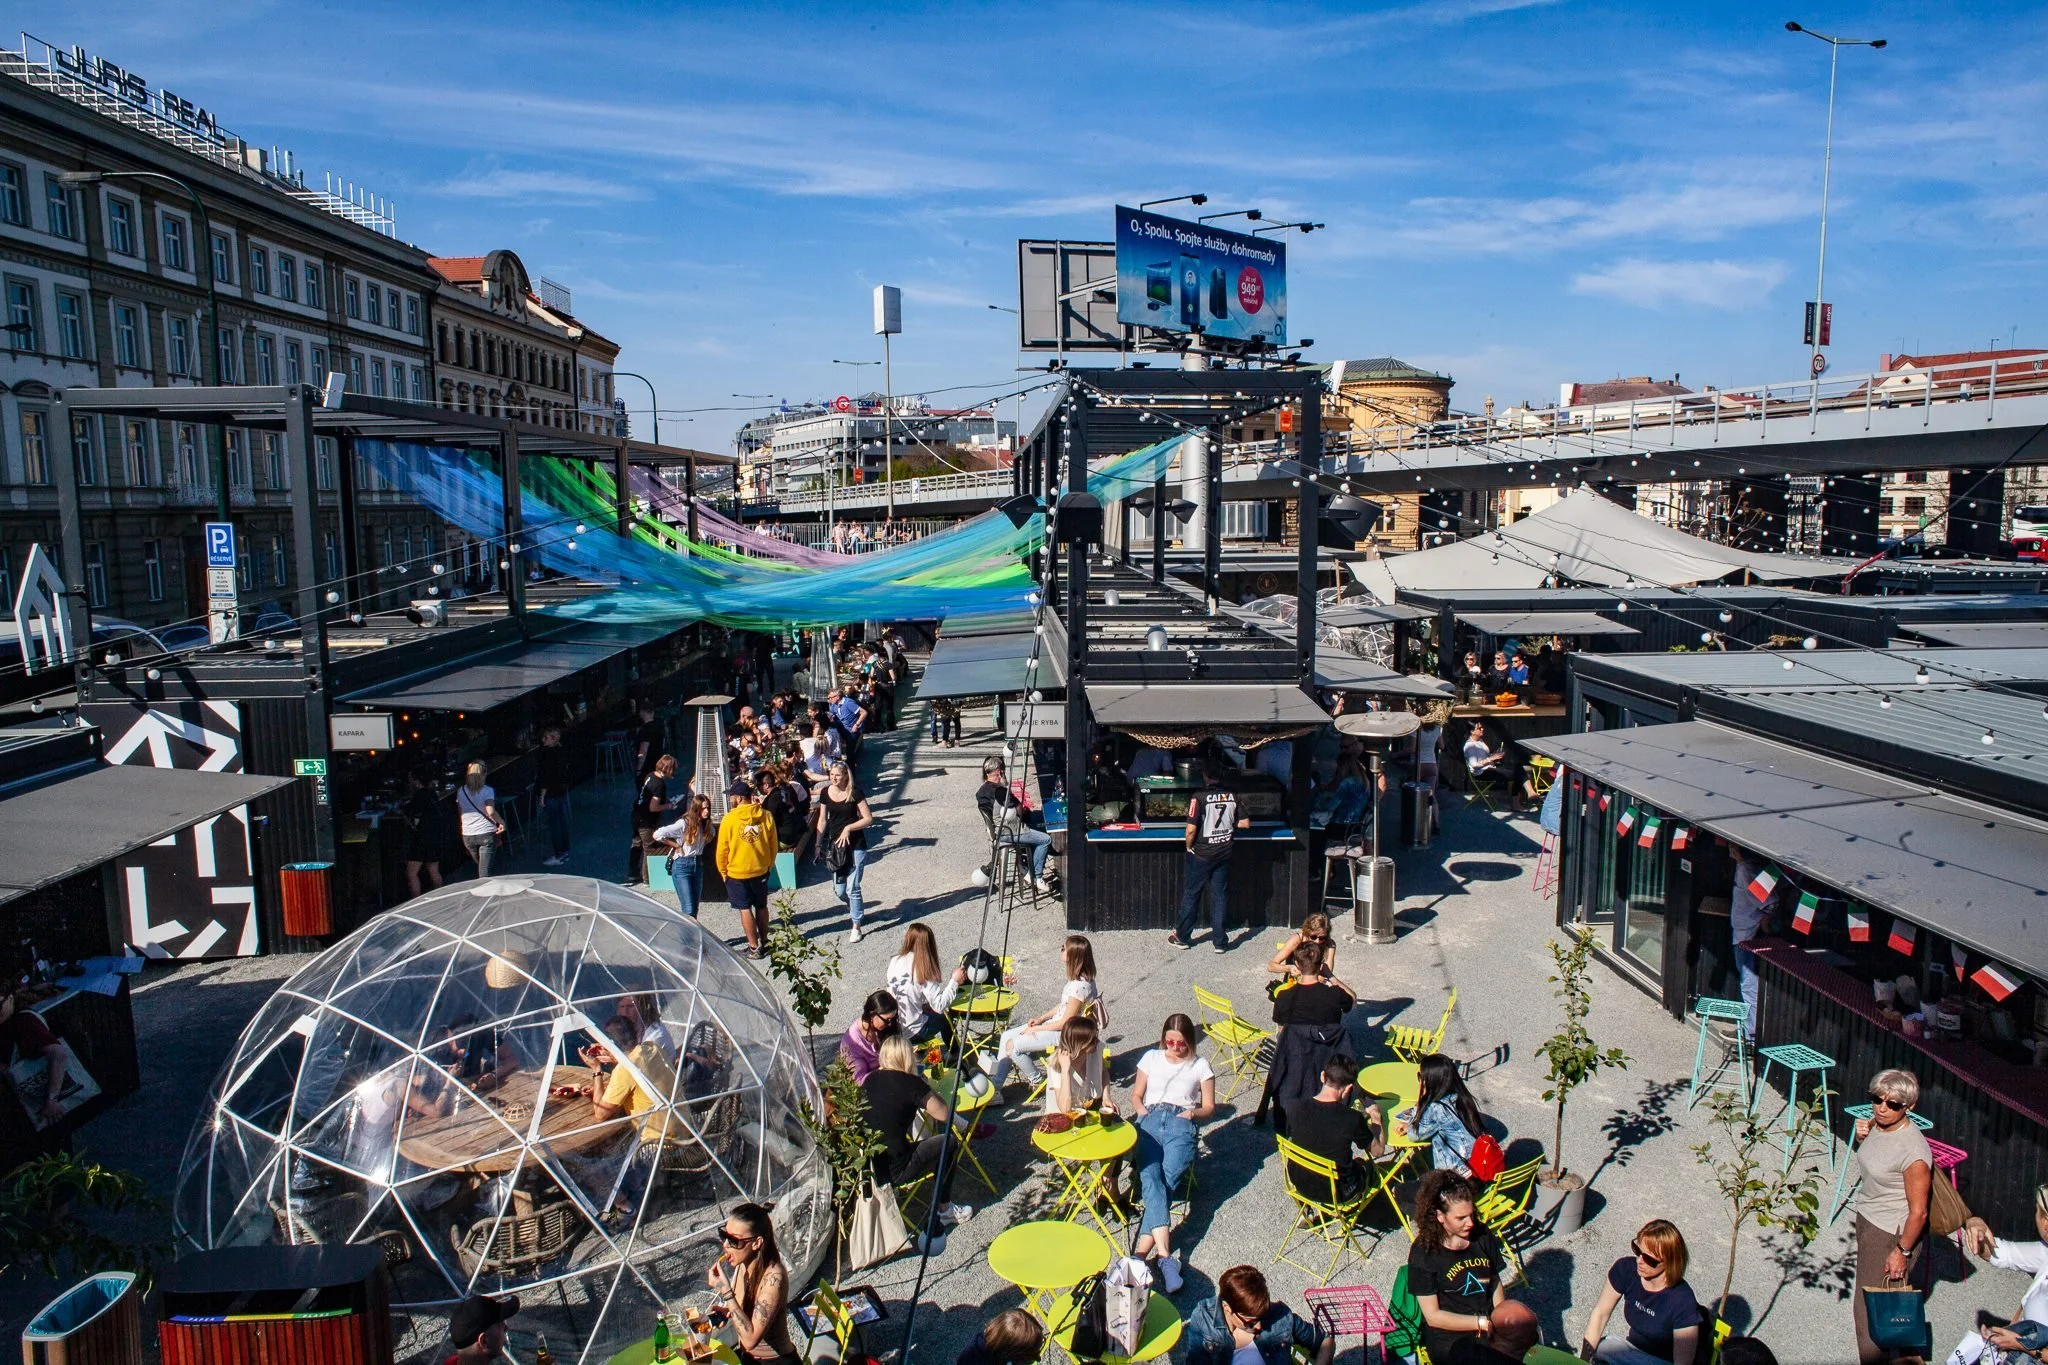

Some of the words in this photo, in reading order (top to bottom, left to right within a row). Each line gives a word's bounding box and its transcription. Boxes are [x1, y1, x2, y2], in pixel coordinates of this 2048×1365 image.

[56, 44, 148, 104] JURIS
[160, 88, 226, 142] REAL
[1144, 221, 1173, 240] Spolu.
[1175, 228, 1202, 248] Spojte
[1204, 236, 1230, 256] služby
[1232, 241, 1276, 266] dohromady
[1241, 282, 1256, 296] 949
[211, 528, 228, 553] P
[1206, 792, 1235, 802] CAIXA
[1214, 804, 1227, 829] 7
[1446, 1261, 1464, 1281] PINK
